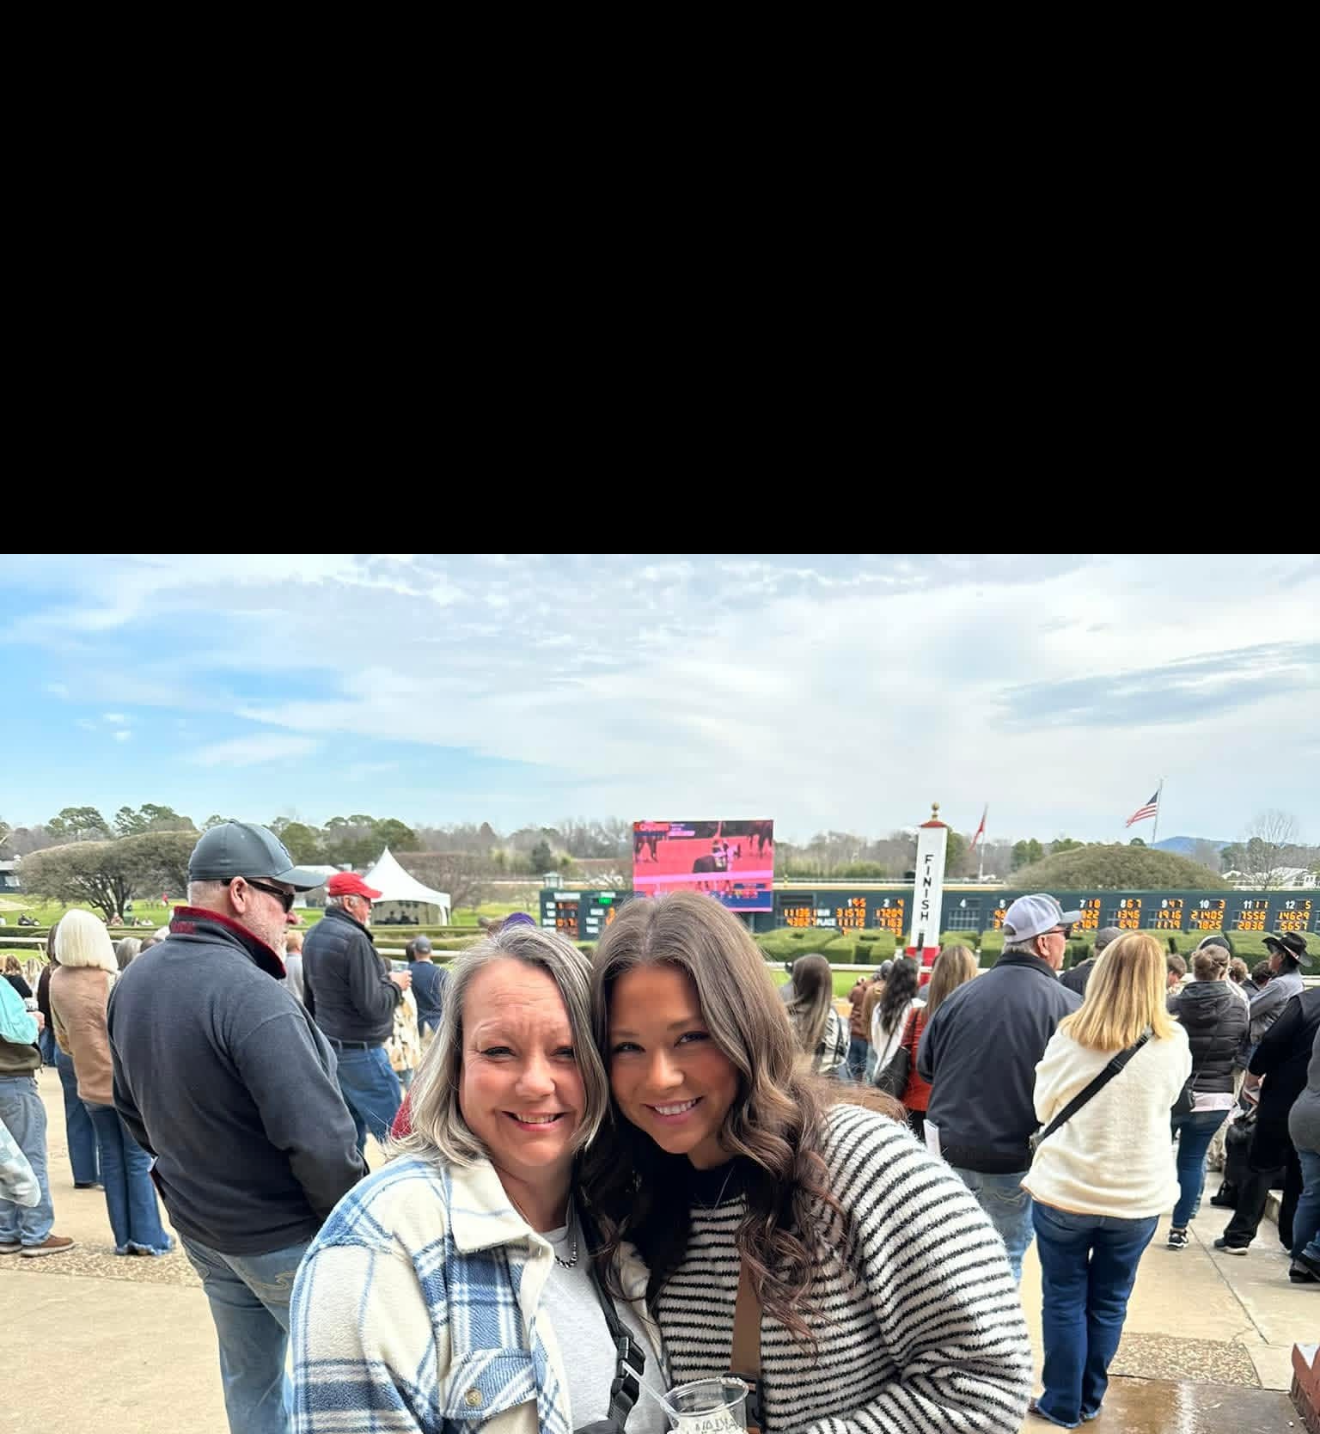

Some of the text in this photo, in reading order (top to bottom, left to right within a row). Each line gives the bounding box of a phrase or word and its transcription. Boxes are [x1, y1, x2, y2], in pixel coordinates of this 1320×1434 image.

[920, 854, 934, 921] FINISH
[960, 899, 967, 908] 4
[1000, 899, 1006, 908] 5
[1080, 899, 1086, 908] 7
[1161, 899, 1168, 908] 9
[1199, 900, 1210, 909] 10
[1219, 899, 1226, 909] 3
[1243, 900, 1253, 909] 11
[1285, 900, 1295, 909] 12
[1305, 900, 1312, 910] 5
[1191, 910, 1224, 920] 21405
[1279, 911, 1310, 920] 14629
